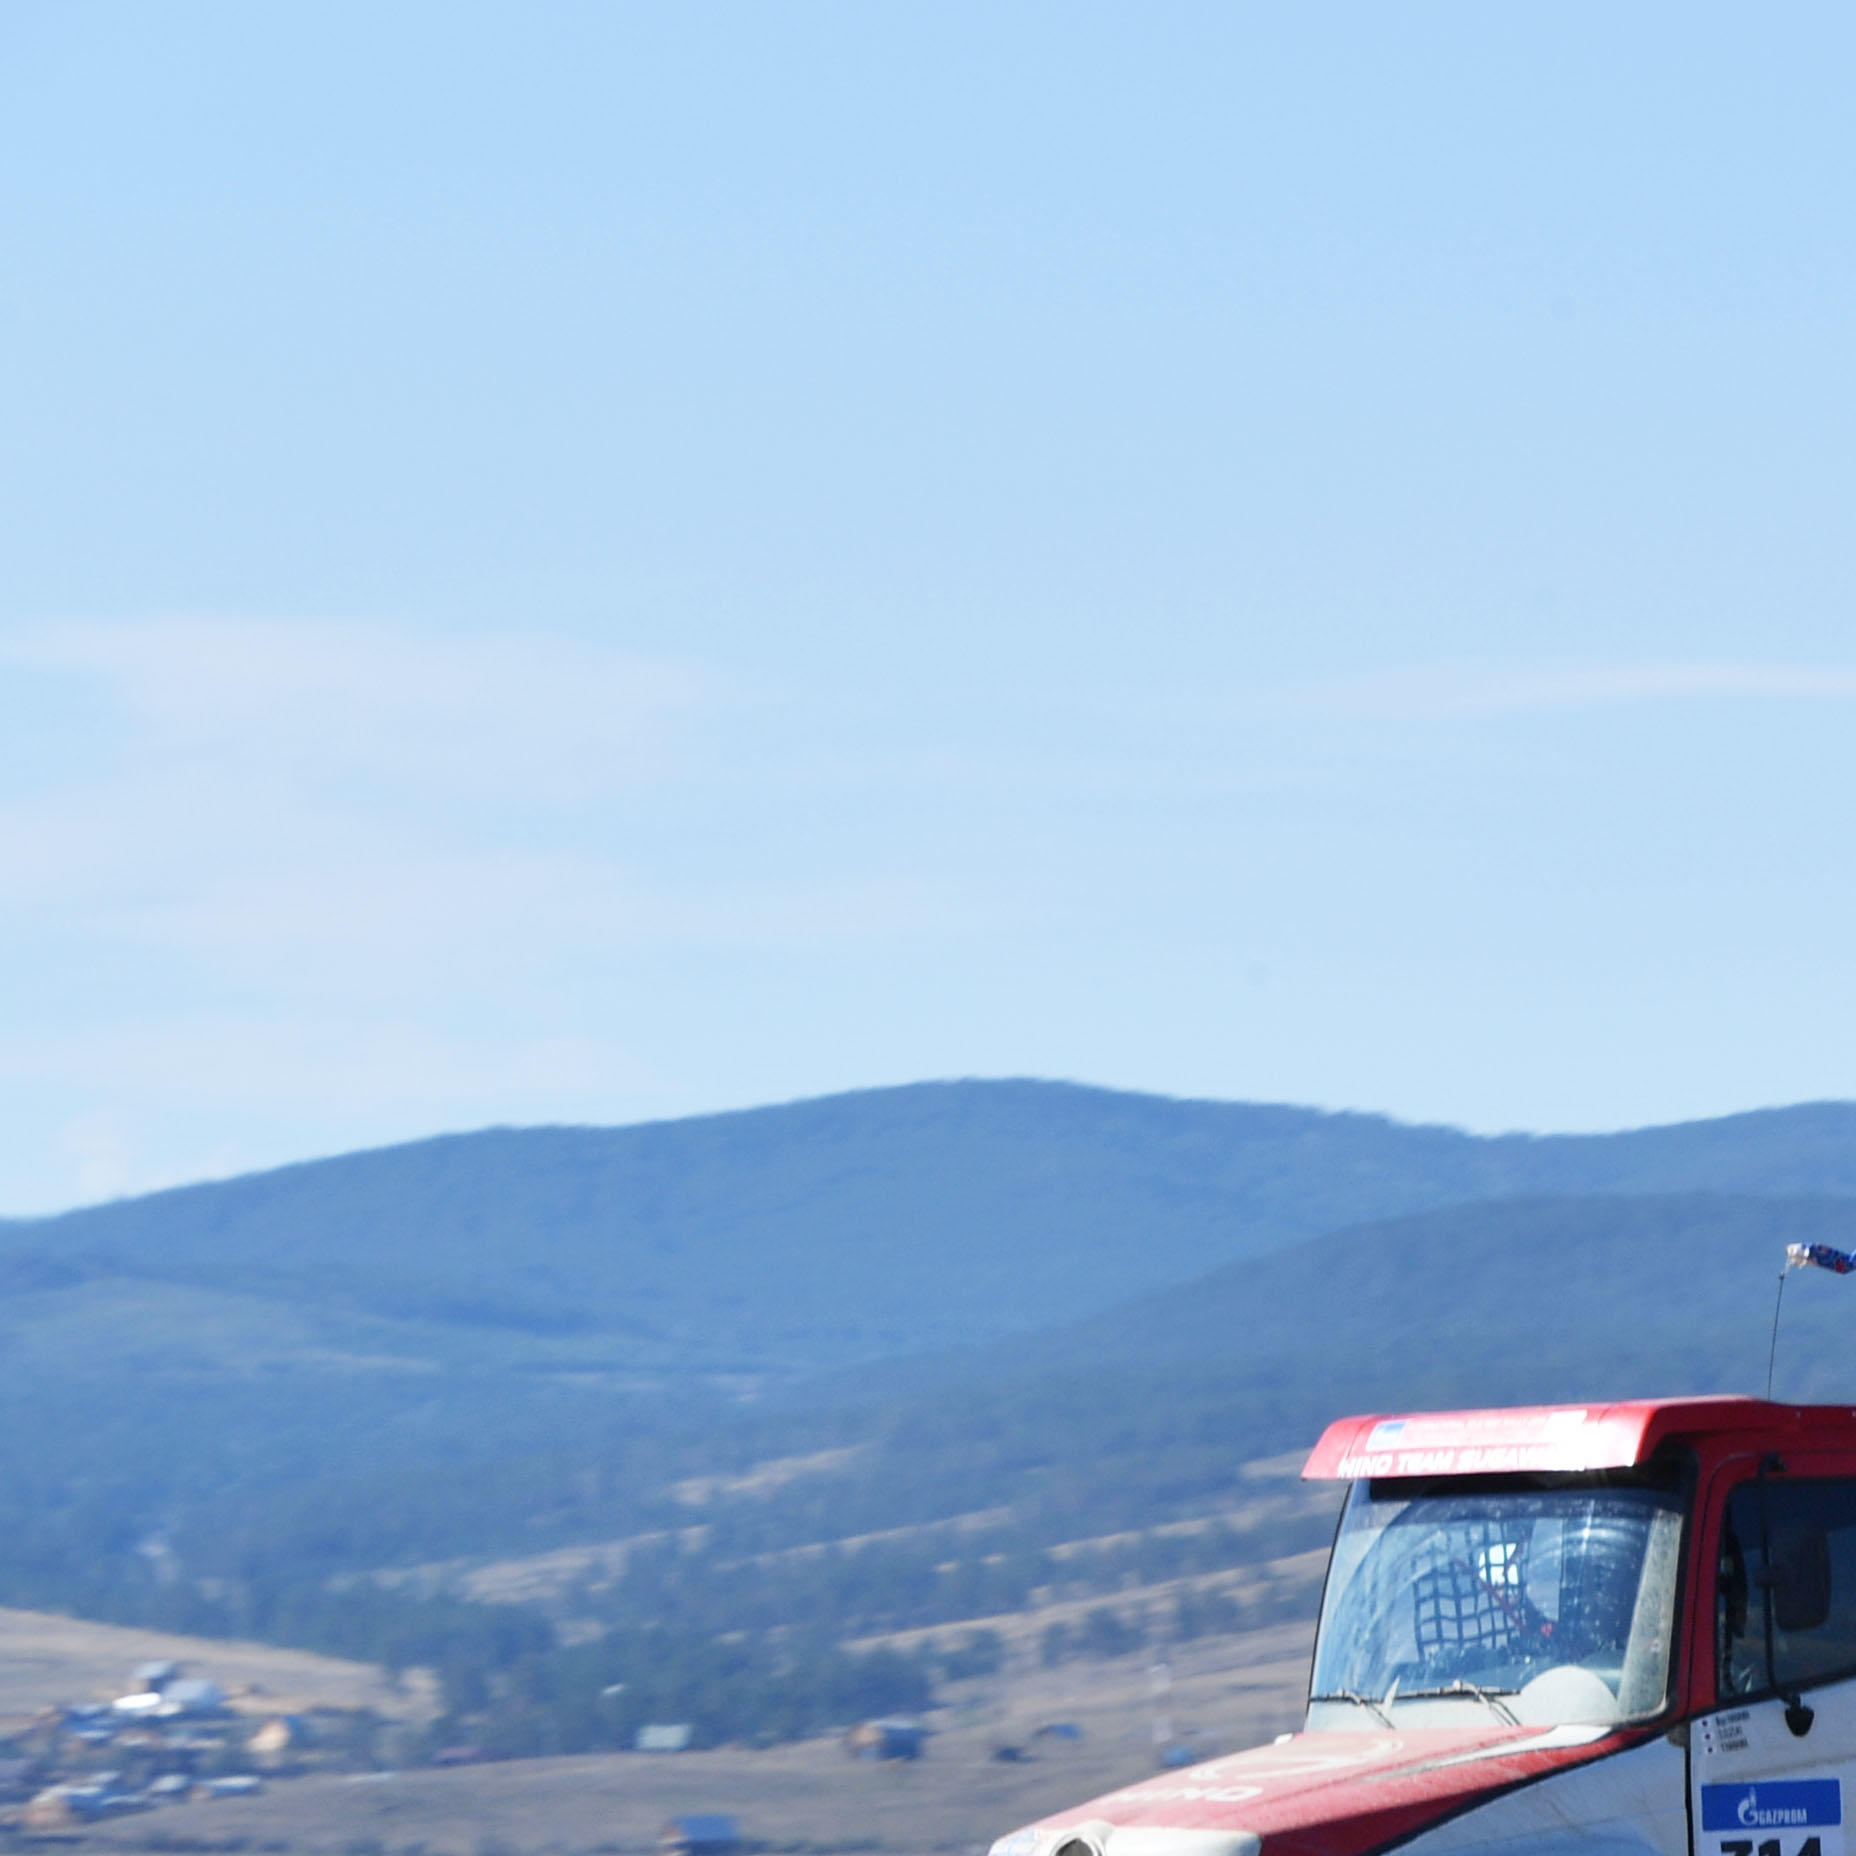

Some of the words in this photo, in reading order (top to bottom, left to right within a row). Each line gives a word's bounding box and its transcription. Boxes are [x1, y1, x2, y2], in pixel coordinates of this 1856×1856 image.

[1337, 1449, 1393, 1479] HINO
[1396, 1446, 1455, 1476] TEAM
[1759, 1807, 1808, 1825] GAZPROM
